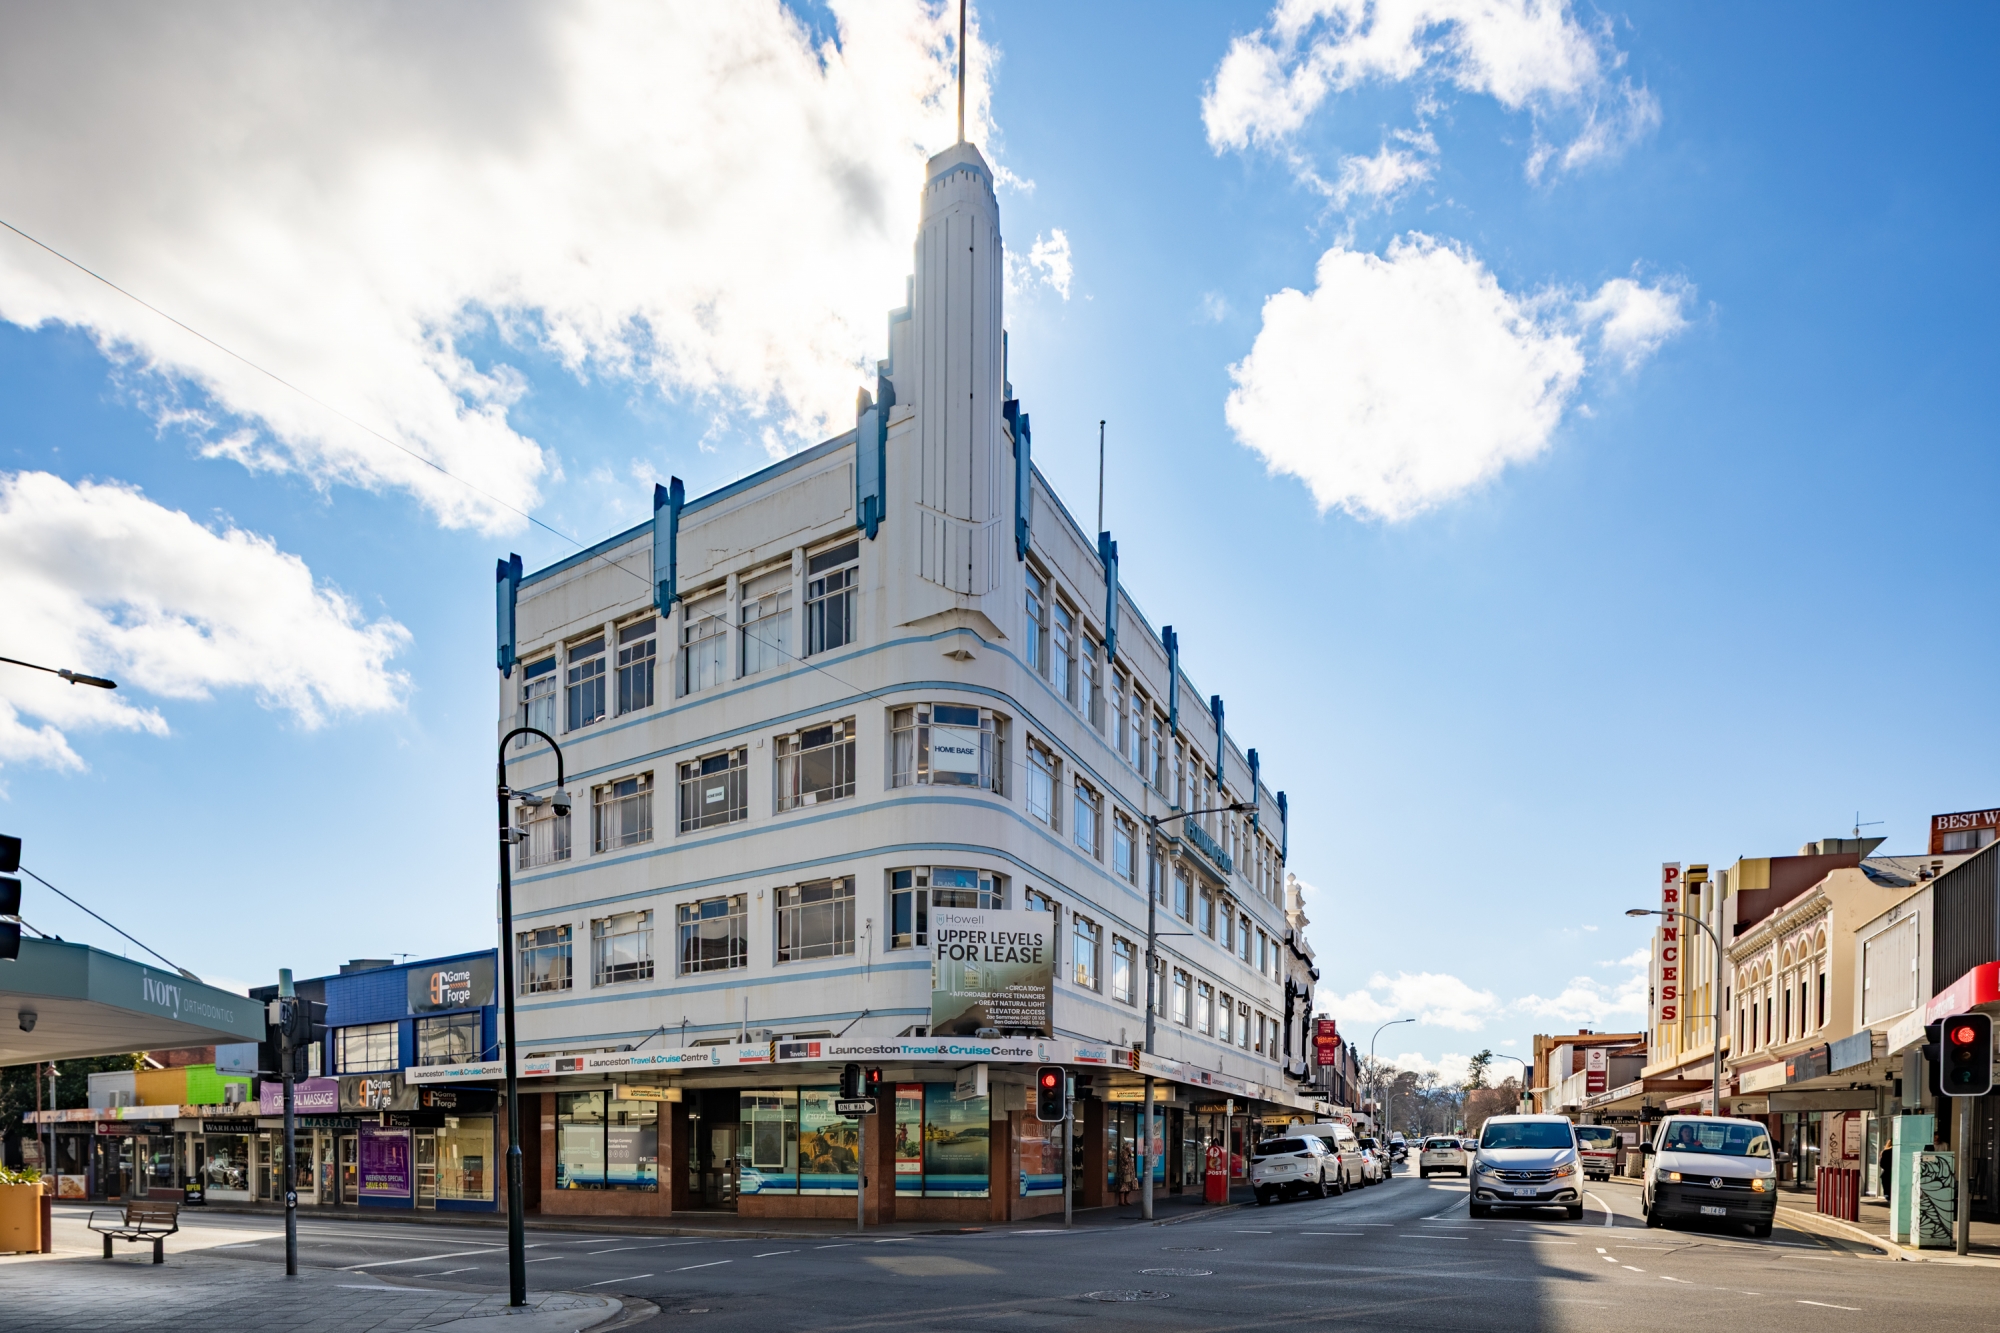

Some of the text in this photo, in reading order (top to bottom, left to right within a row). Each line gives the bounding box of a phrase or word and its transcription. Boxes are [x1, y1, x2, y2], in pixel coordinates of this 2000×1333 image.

[934, 745, 974, 755] HOME BASE
[1937, 813, 1981, 830] BEST
[946, 914, 984, 925] Howell
[937, 929, 1043, 946] UPPER LEVELS
[1662, 867, 1679, 1020] PRINCESS
[938, 944, 1042, 964] FOR LEASE
[447, 971, 470, 982] Game
[143, 968, 234, 1023] ivory ORTHODONTICS
[447, 990, 470, 1003] Forge
[1074, 1048, 1106, 1059] helloworld
[525, 1061, 550, 1071] helloworld
[304, 1093, 334, 1105] MASSAGE
[840, 1103, 851, 1111] ONE
[205, 1124, 258, 1132] WARHAMMER
[305, 1118, 358, 1127] MASSAGE
